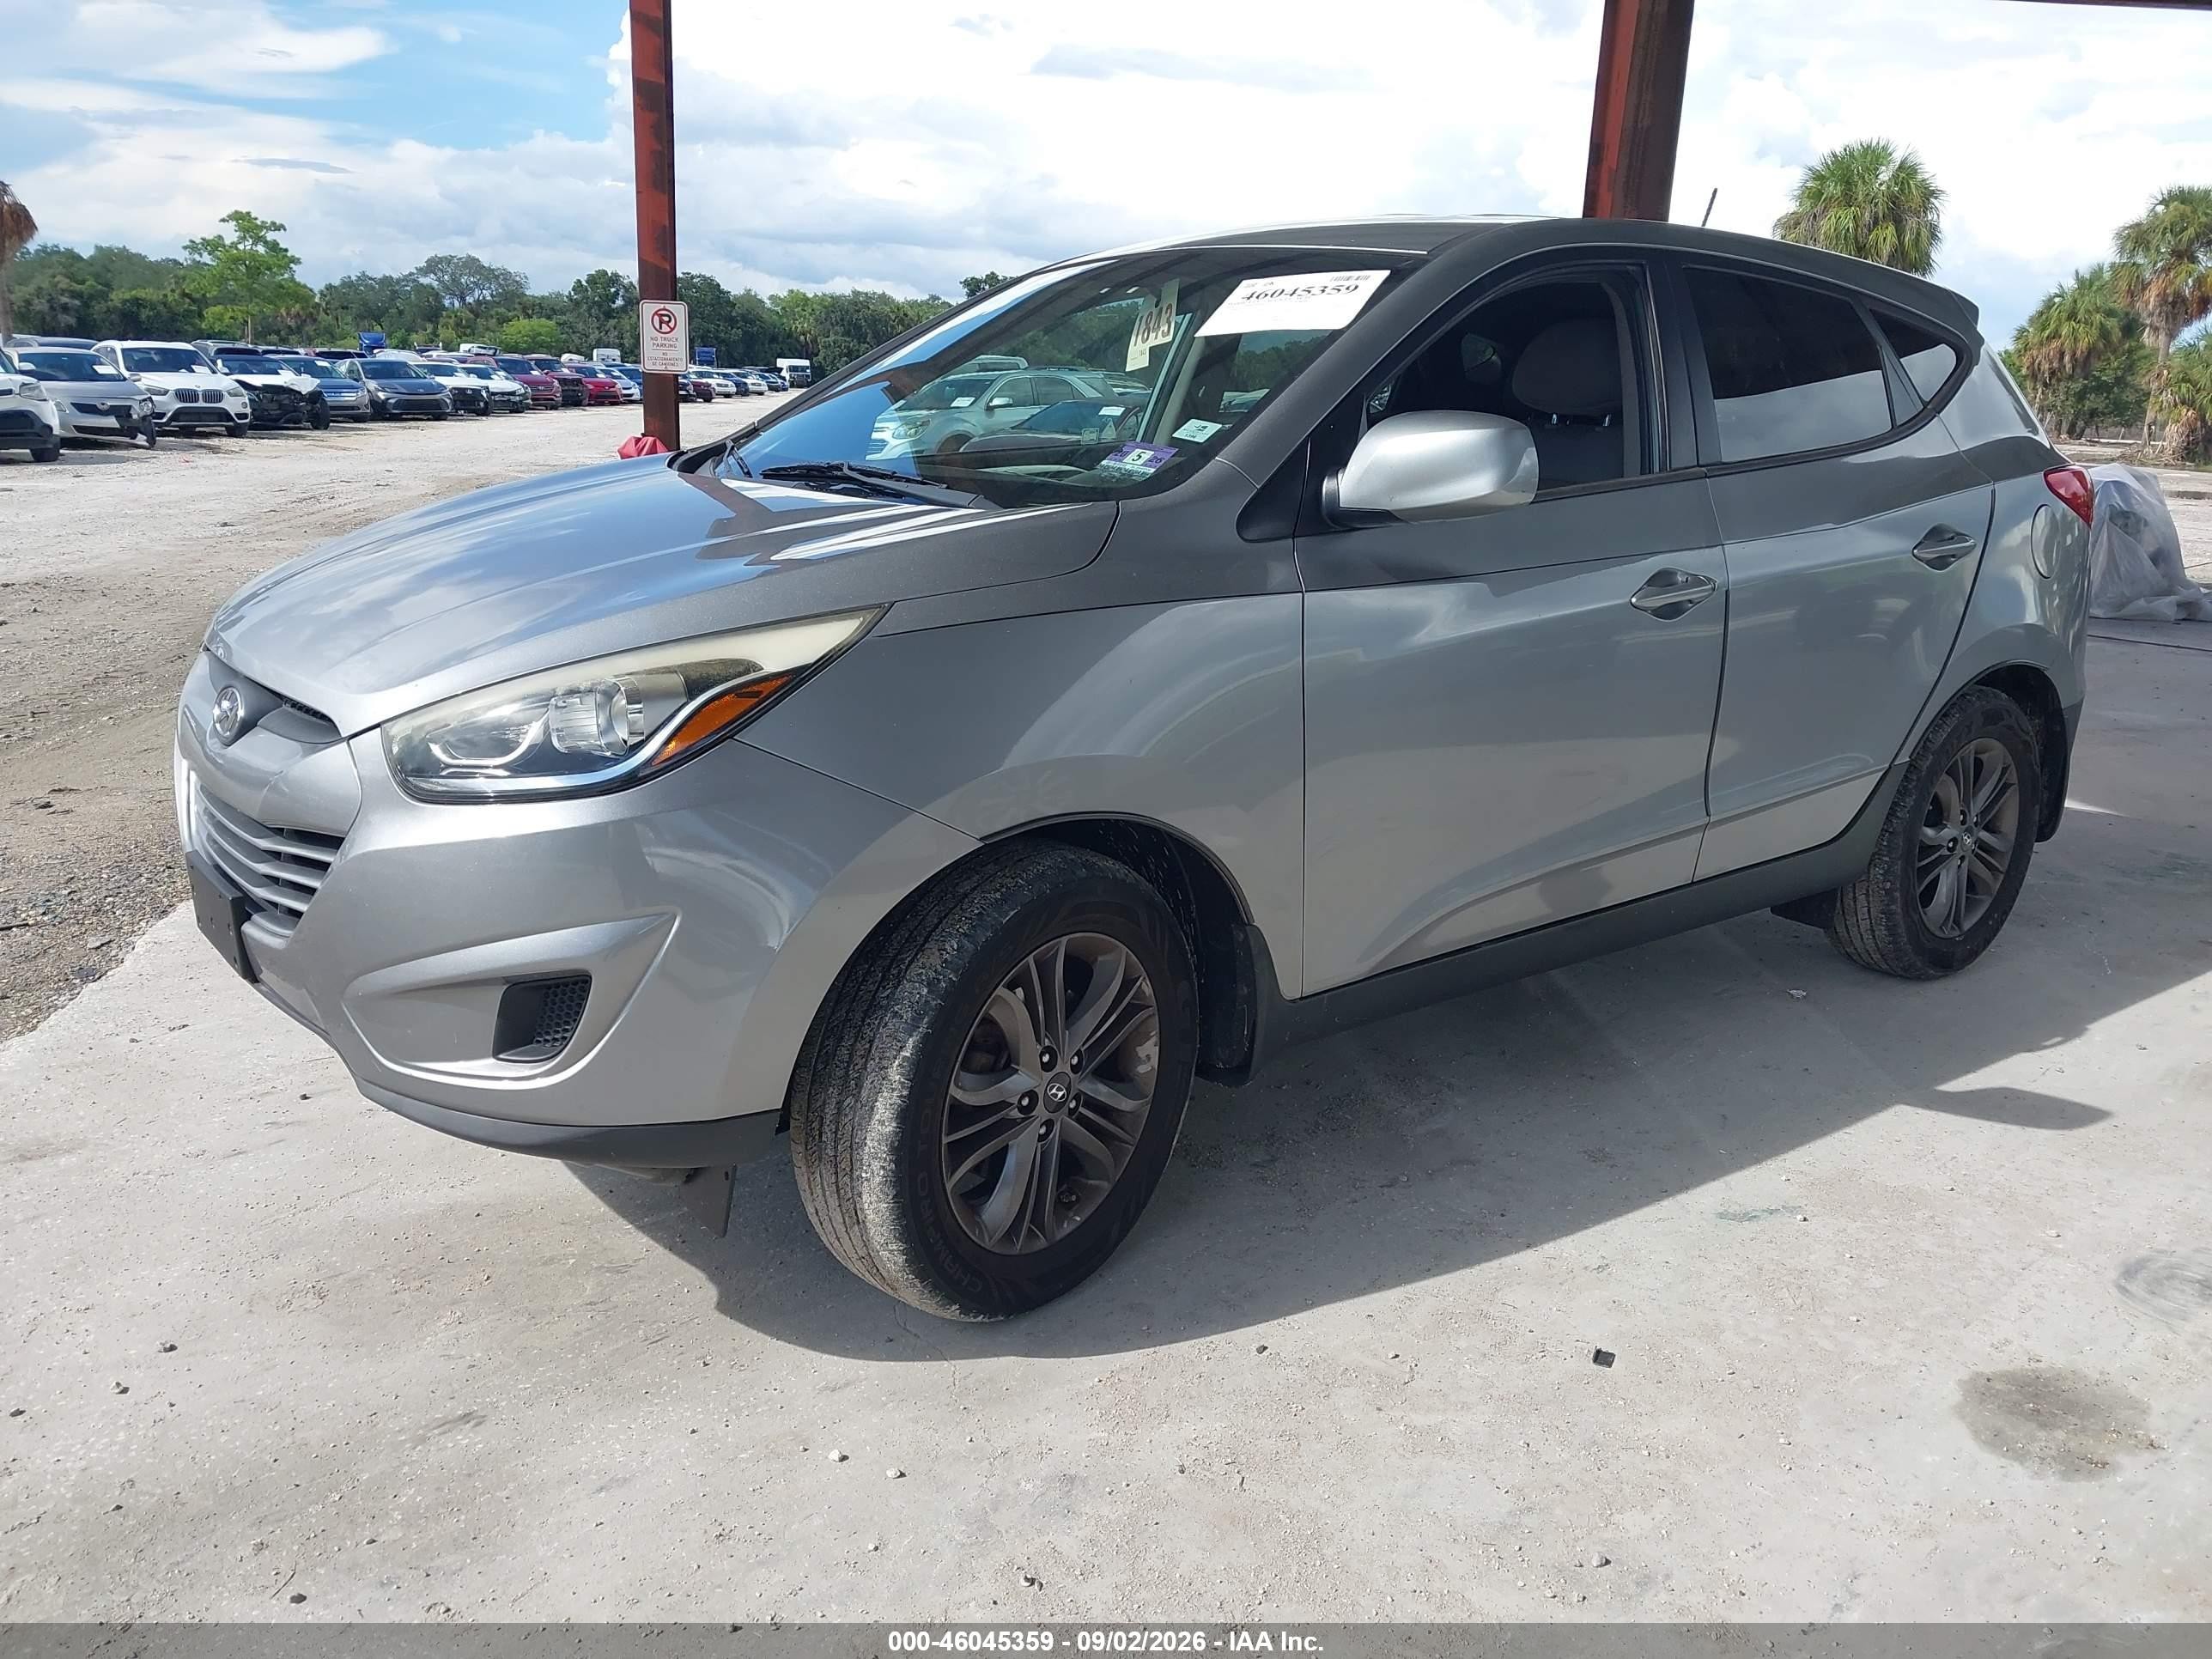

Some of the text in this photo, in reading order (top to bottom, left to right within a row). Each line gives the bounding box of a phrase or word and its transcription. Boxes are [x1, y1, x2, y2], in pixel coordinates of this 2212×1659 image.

[1242, 283, 1358, 301] 46045359
[1133, 303, 1173, 347] 1843
[1132, 451, 1146, 462] 5
